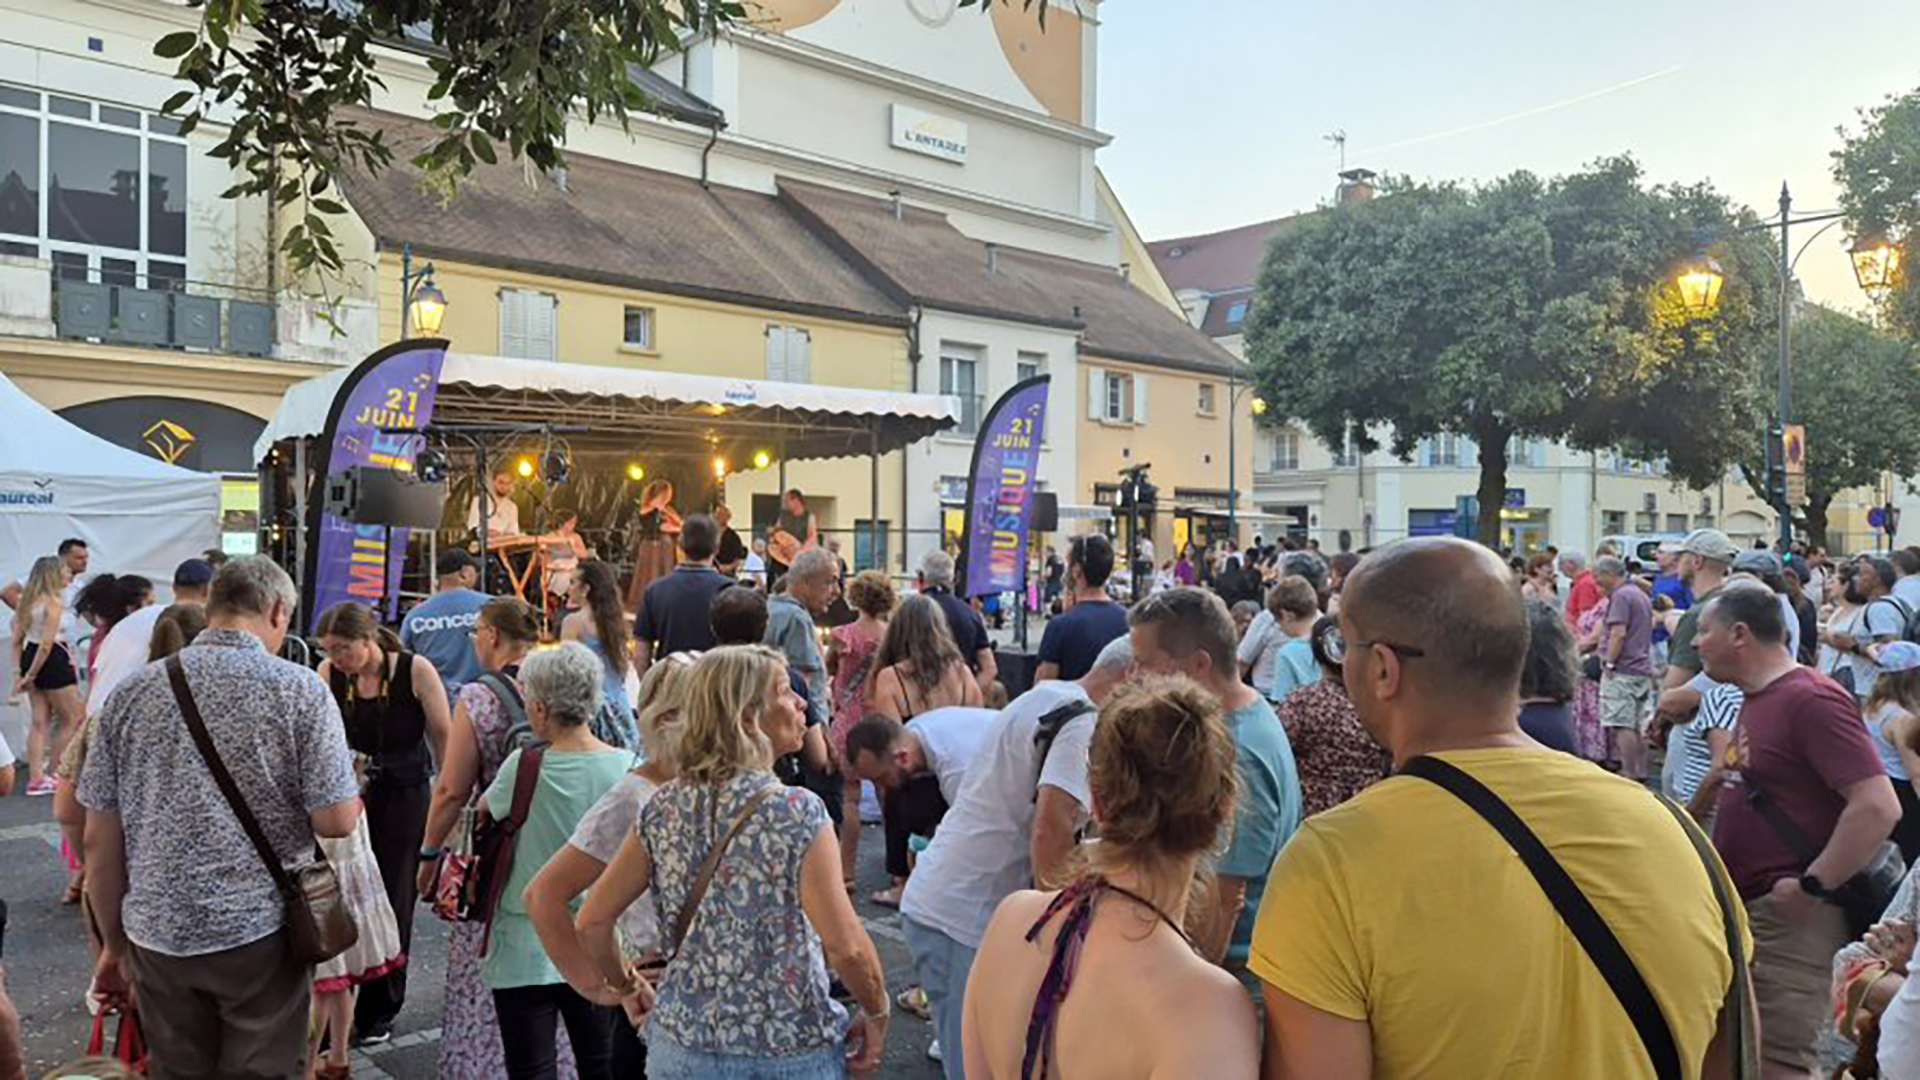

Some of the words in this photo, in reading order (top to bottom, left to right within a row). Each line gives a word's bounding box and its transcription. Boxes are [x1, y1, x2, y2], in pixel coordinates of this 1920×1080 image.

[384, 387, 419, 412] 21
[356, 406, 416, 428] JUIN
[1010, 418, 1033, 433] 21
[992, 434, 1031, 449] JUIN
[990, 450, 1028, 577] MUSIQUE
[410, 612, 481, 634] Conce
